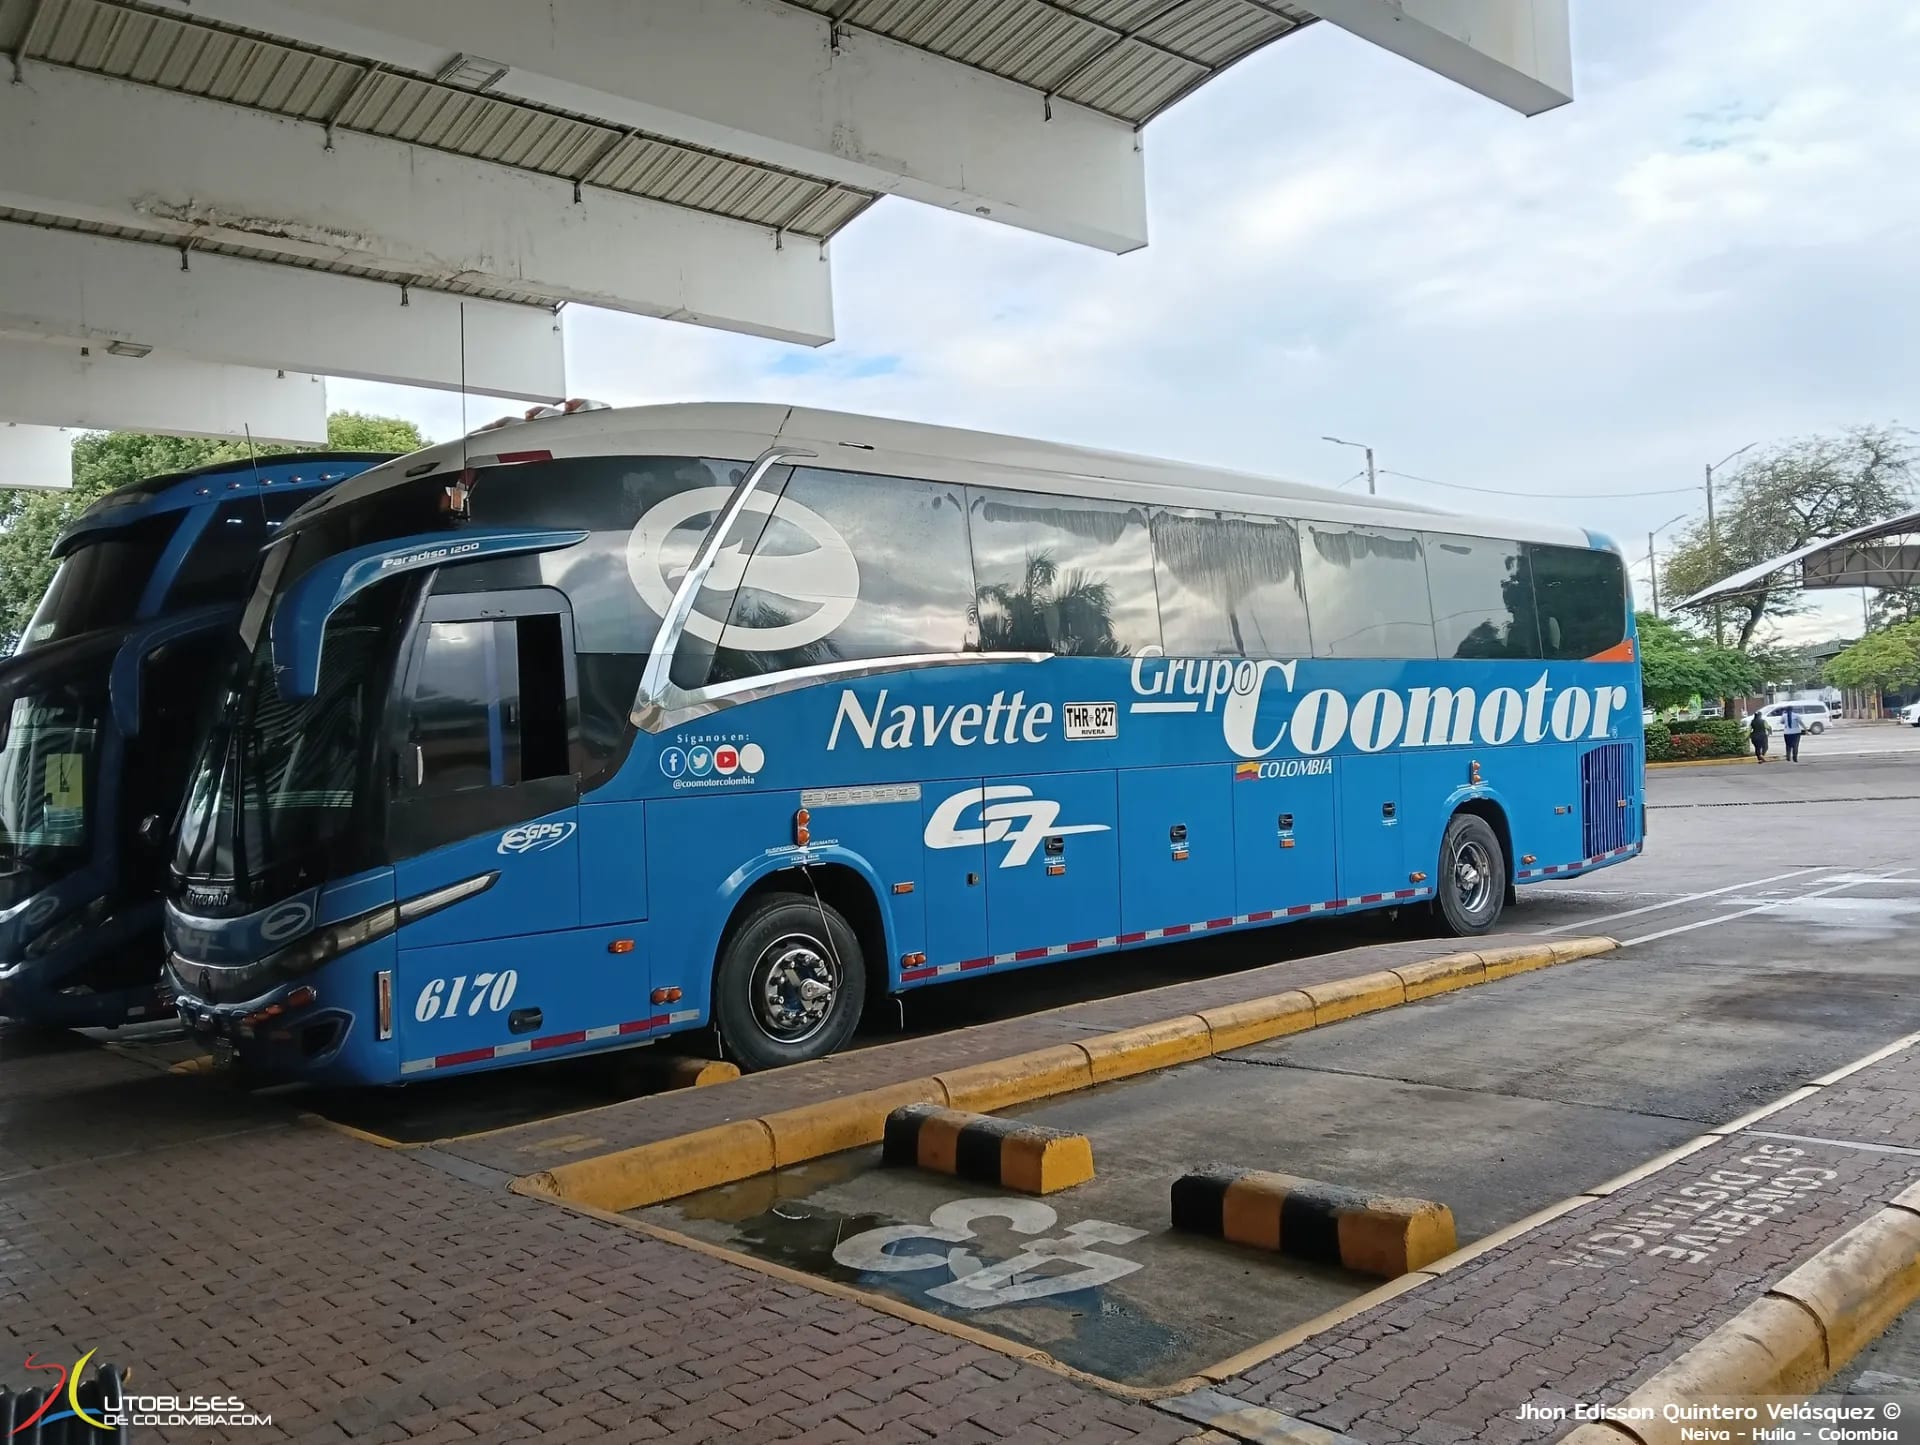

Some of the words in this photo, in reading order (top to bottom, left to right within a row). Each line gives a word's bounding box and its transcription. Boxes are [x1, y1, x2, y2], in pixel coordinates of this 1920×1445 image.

[381, 549, 447, 569] Paradiso
[450, 542, 480, 555] 1200
[1130, 645, 1258, 712] Grupo
[827, 688, 1053, 750] Navette
[1094, 707, 1115, 727] 827
[1223, 660, 1627, 758] Coomotor
[677, 733, 727, 745] Síganos
[730, 733, 751, 742] en:
[1080, 728, 1106, 736] RIVERA
[1257, 758, 1333, 779] COLOMBIA
[672, 776, 755, 790] @coomotorcolombia
[415, 969, 518, 1023] 6170
[1739, 1143, 1806, 1168] SU
[1547, 1169, 1764, 1269] DISTANCIA
[1646, 1166, 1839, 1264] CONSERVE
